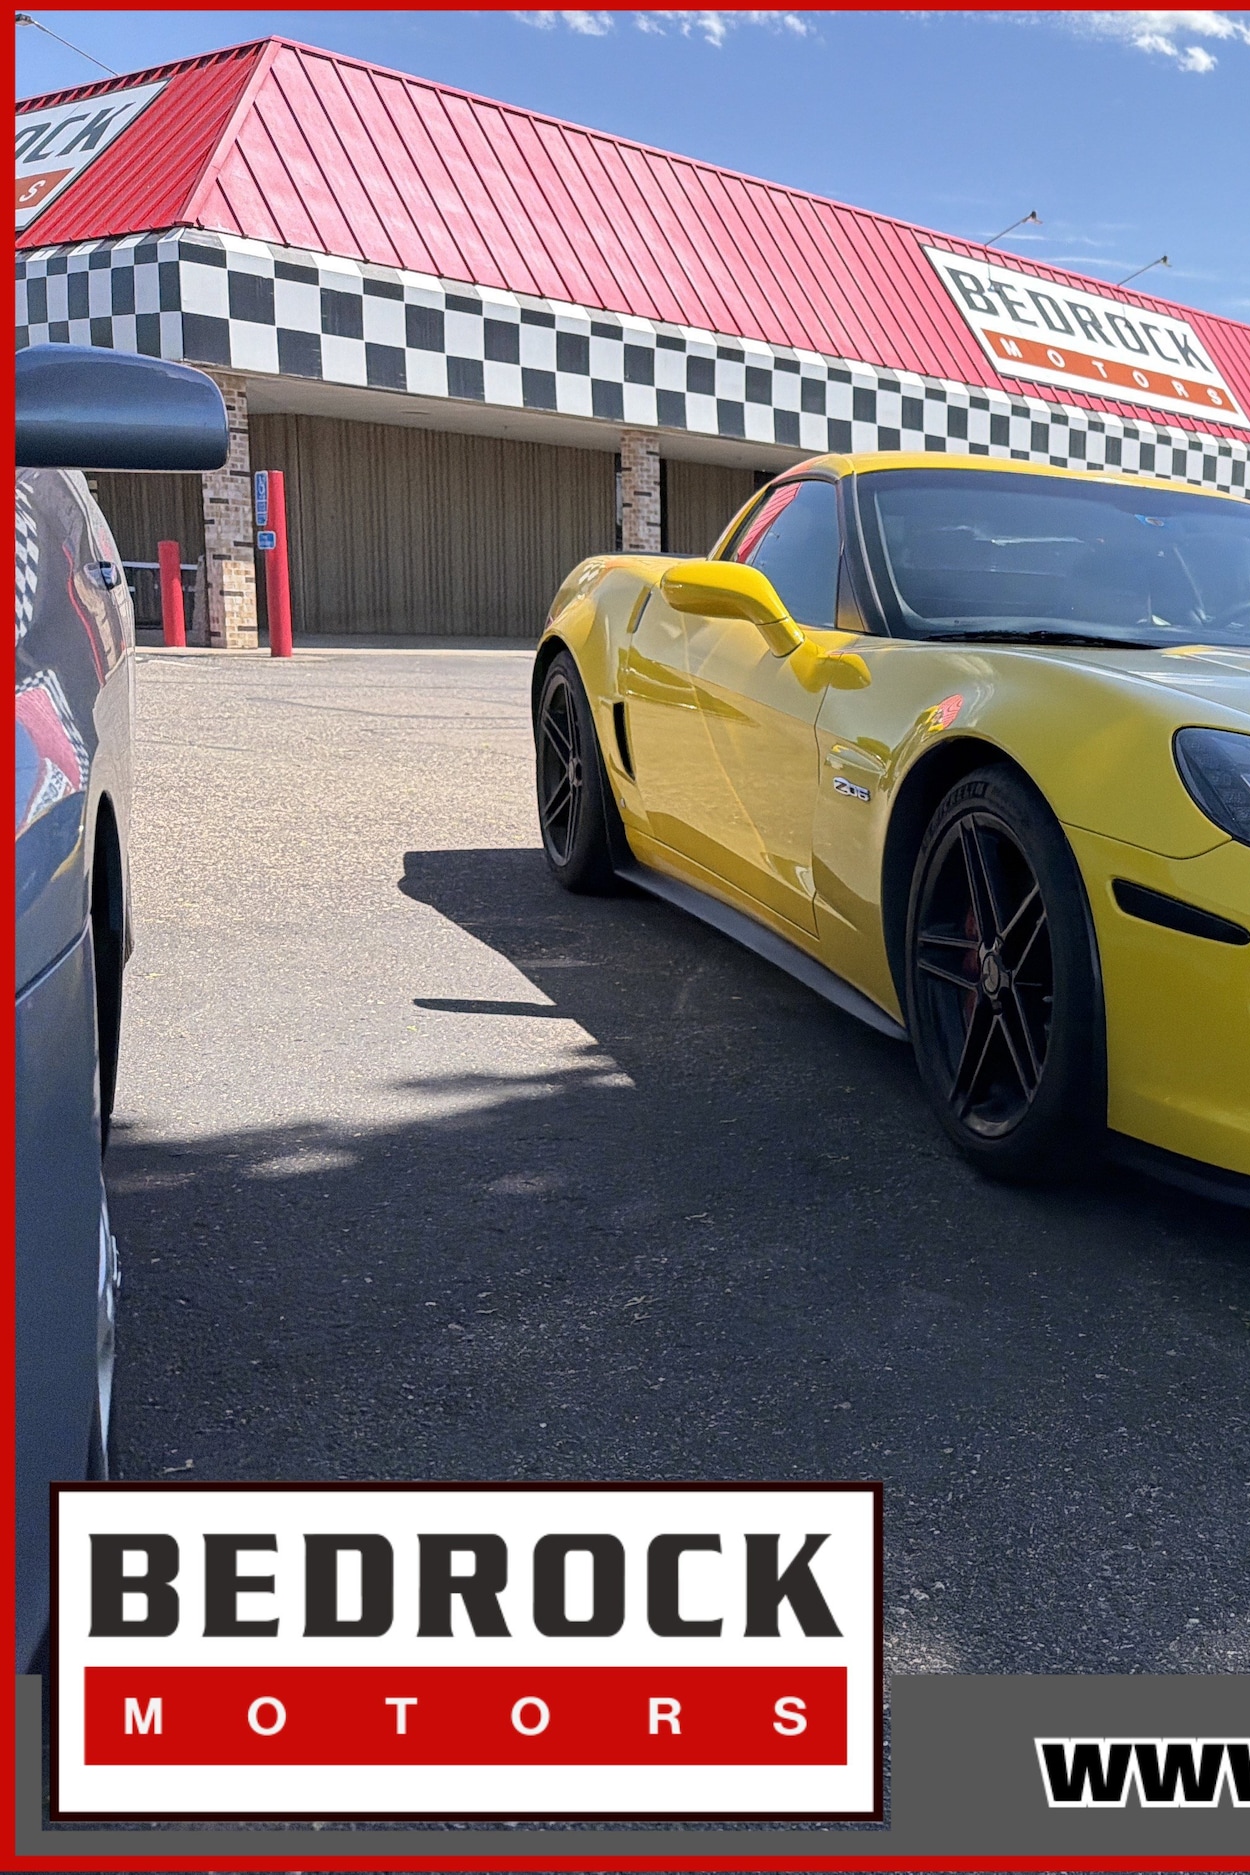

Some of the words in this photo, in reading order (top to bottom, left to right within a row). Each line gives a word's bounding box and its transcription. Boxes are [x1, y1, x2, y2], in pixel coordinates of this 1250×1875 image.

[945, 266, 1213, 373] BEDROCK
[1000, 337, 1223, 406] MOTORS
[833, 776, 871, 802] Z06
